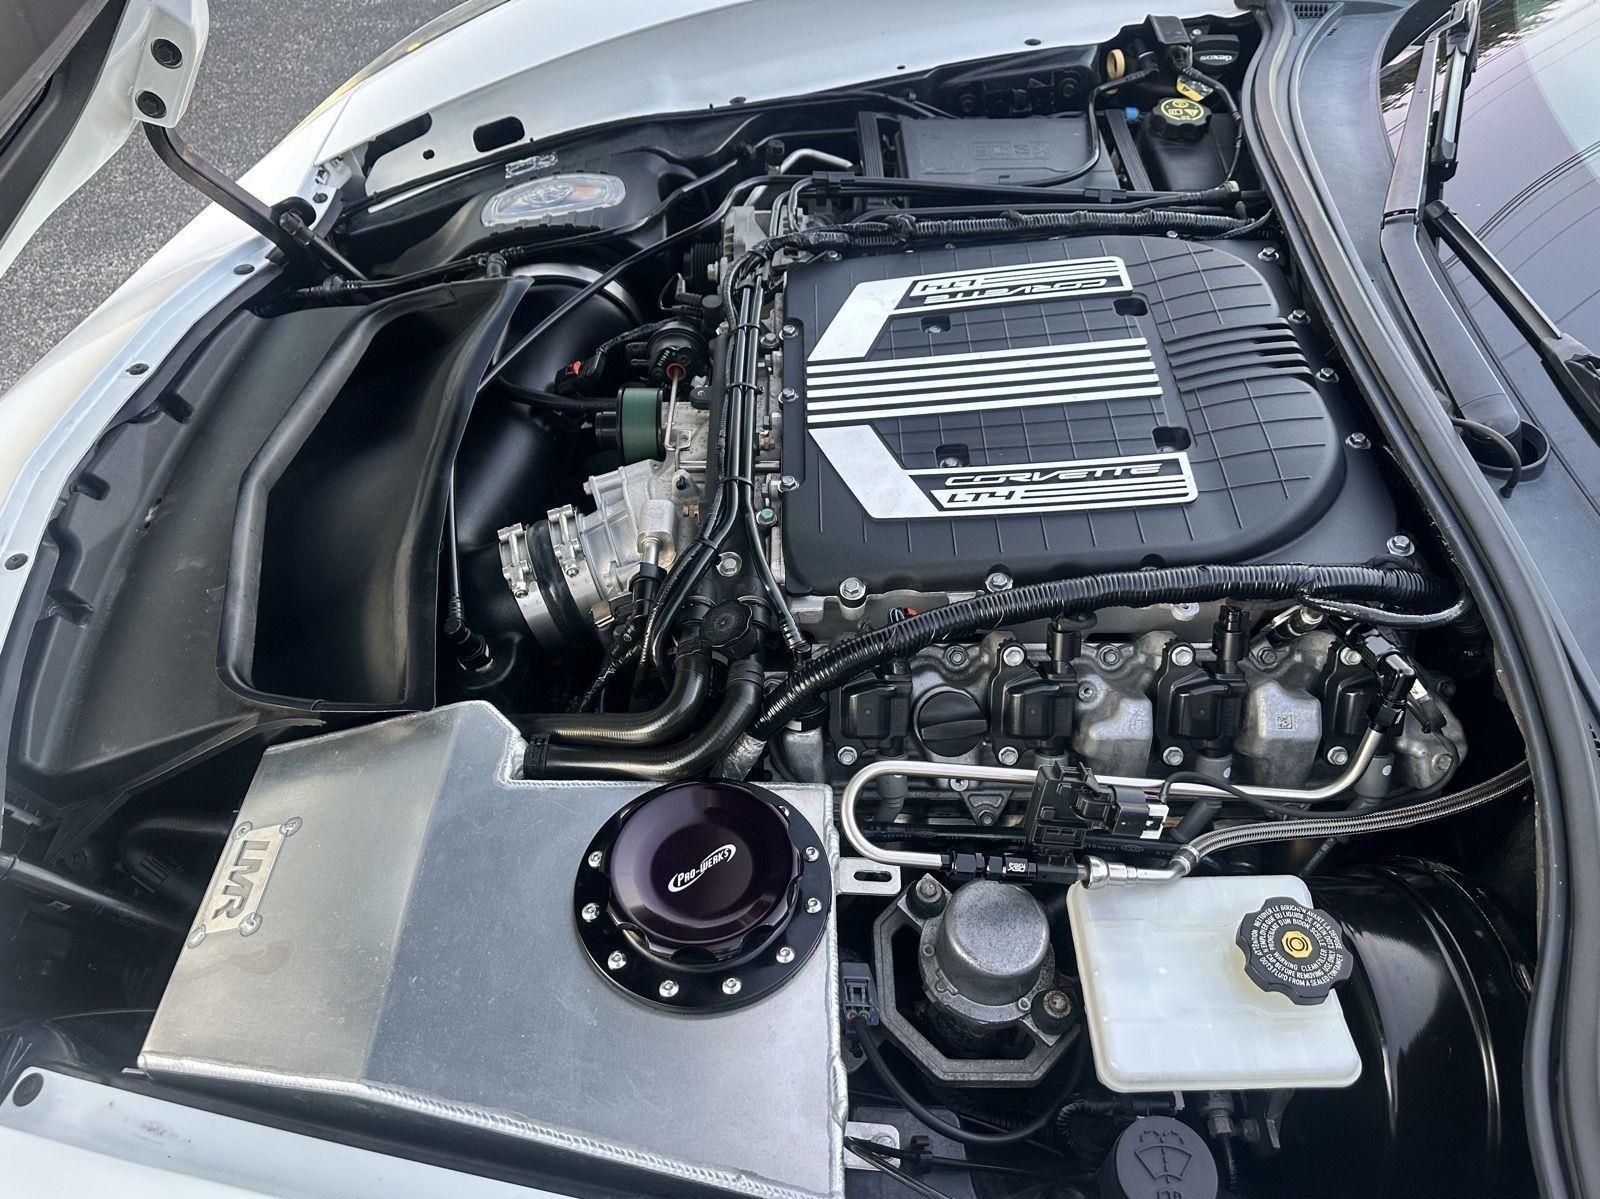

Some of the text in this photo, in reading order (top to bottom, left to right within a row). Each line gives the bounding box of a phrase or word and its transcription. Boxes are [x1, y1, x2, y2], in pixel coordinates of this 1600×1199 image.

[919, 280, 979, 294] LT4
[923, 278, 1107, 304] CORVETTE
[944, 463, 1163, 487] CORVETTE
[946, 489, 1016, 503] LT4
[212, 840, 270, 920] LMR
[1292, 918, 1311, 929] BIDON
[1306, 910, 1325, 924] AVANT
[1322, 921, 1331, 931] LA
[1312, 920, 1328, 936] FREIN
[1266, 949, 1336, 980] CAP BEFORE REMOVING USE ONLY
[1271, 968, 1288, 981] FLUID
[1288, 977, 1306, 987] FROM
[1310, 975, 1331, 987] SEALED
[1327, 953, 1344, 979] CONTAINER
[1273, 948, 1328, 972] WARNING CLEAN FILLER
